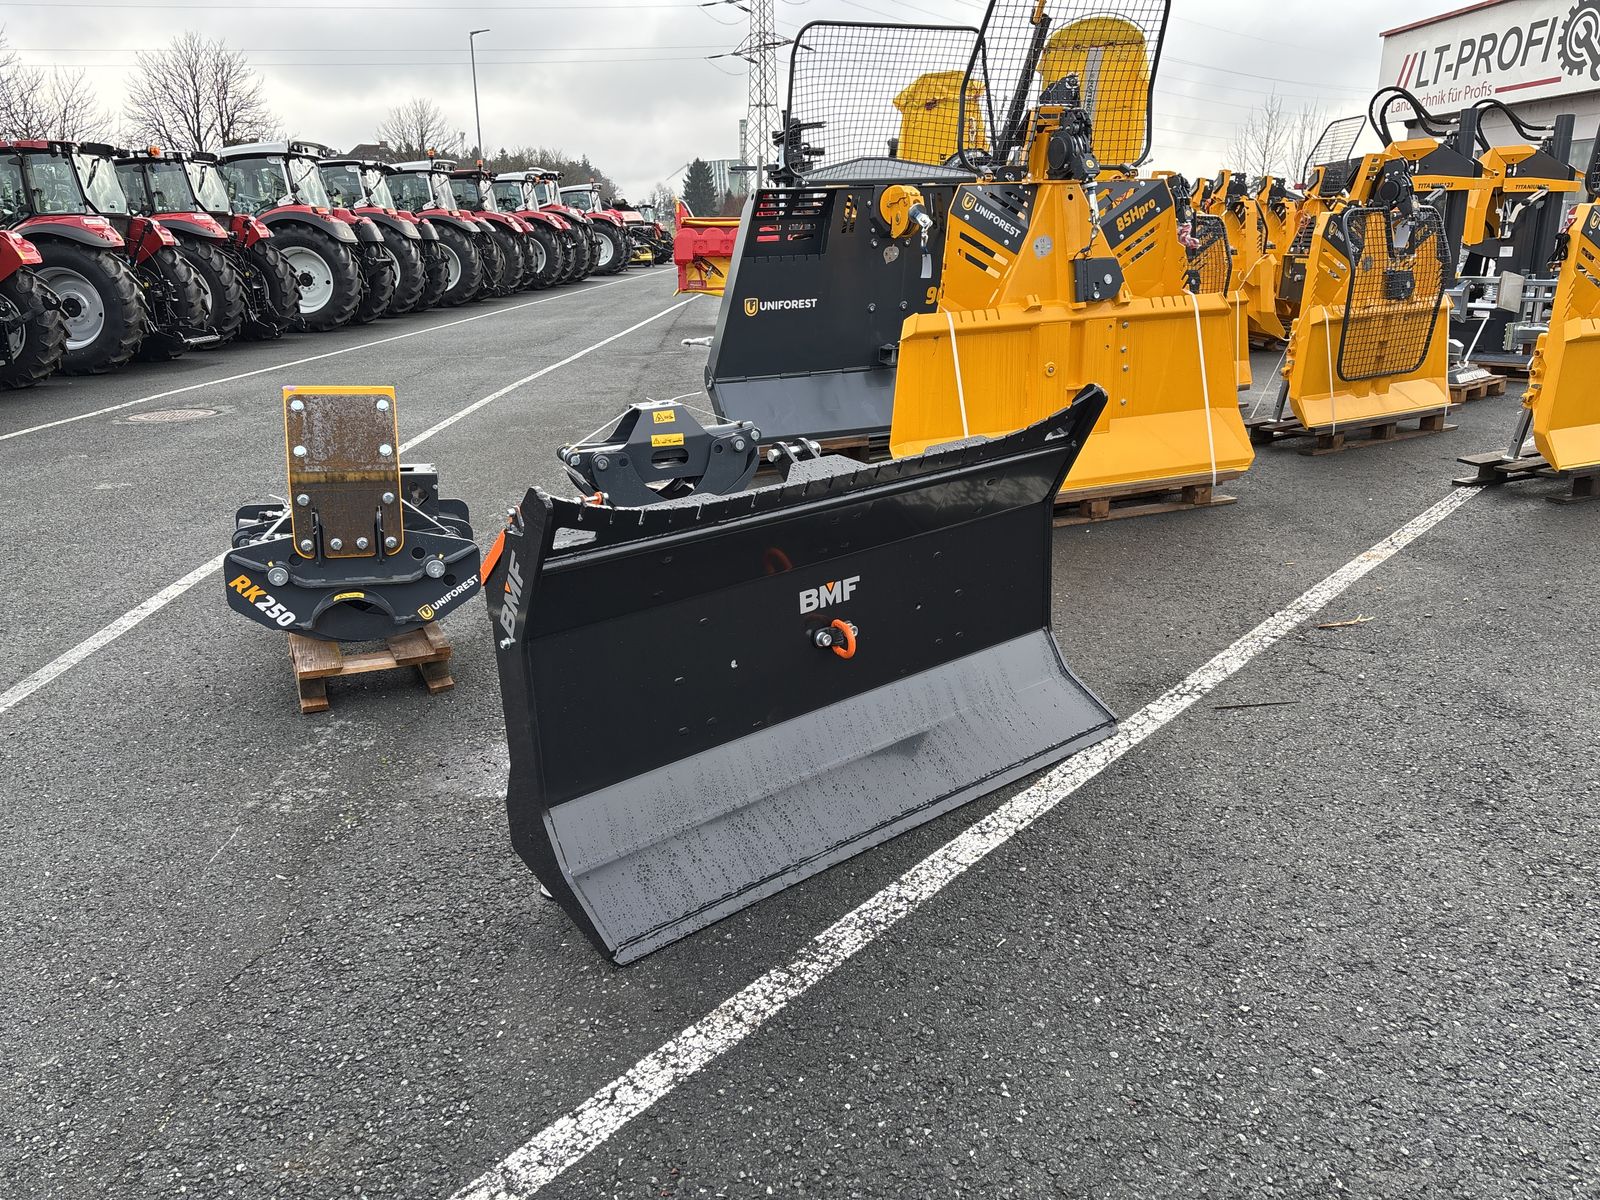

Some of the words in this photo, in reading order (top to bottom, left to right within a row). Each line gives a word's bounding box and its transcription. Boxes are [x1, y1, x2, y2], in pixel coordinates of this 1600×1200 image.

[1391, 89, 1446, 114] Lanchnik
[1448, 87, 1462, 103] für
[1464, 81, 1493, 100] Profis
[974, 203, 1021, 238] UNIFOREST
[1116, 198, 1156, 232] 85Hpro
[760, 298, 818, 311] UNIFOREST
[228, 574, 296, 627] RK250
[431, 574, 479, 610] UNIFOREST
[499, 549, 524, 639] BMF
[799, 575, 861, 615] BMF
